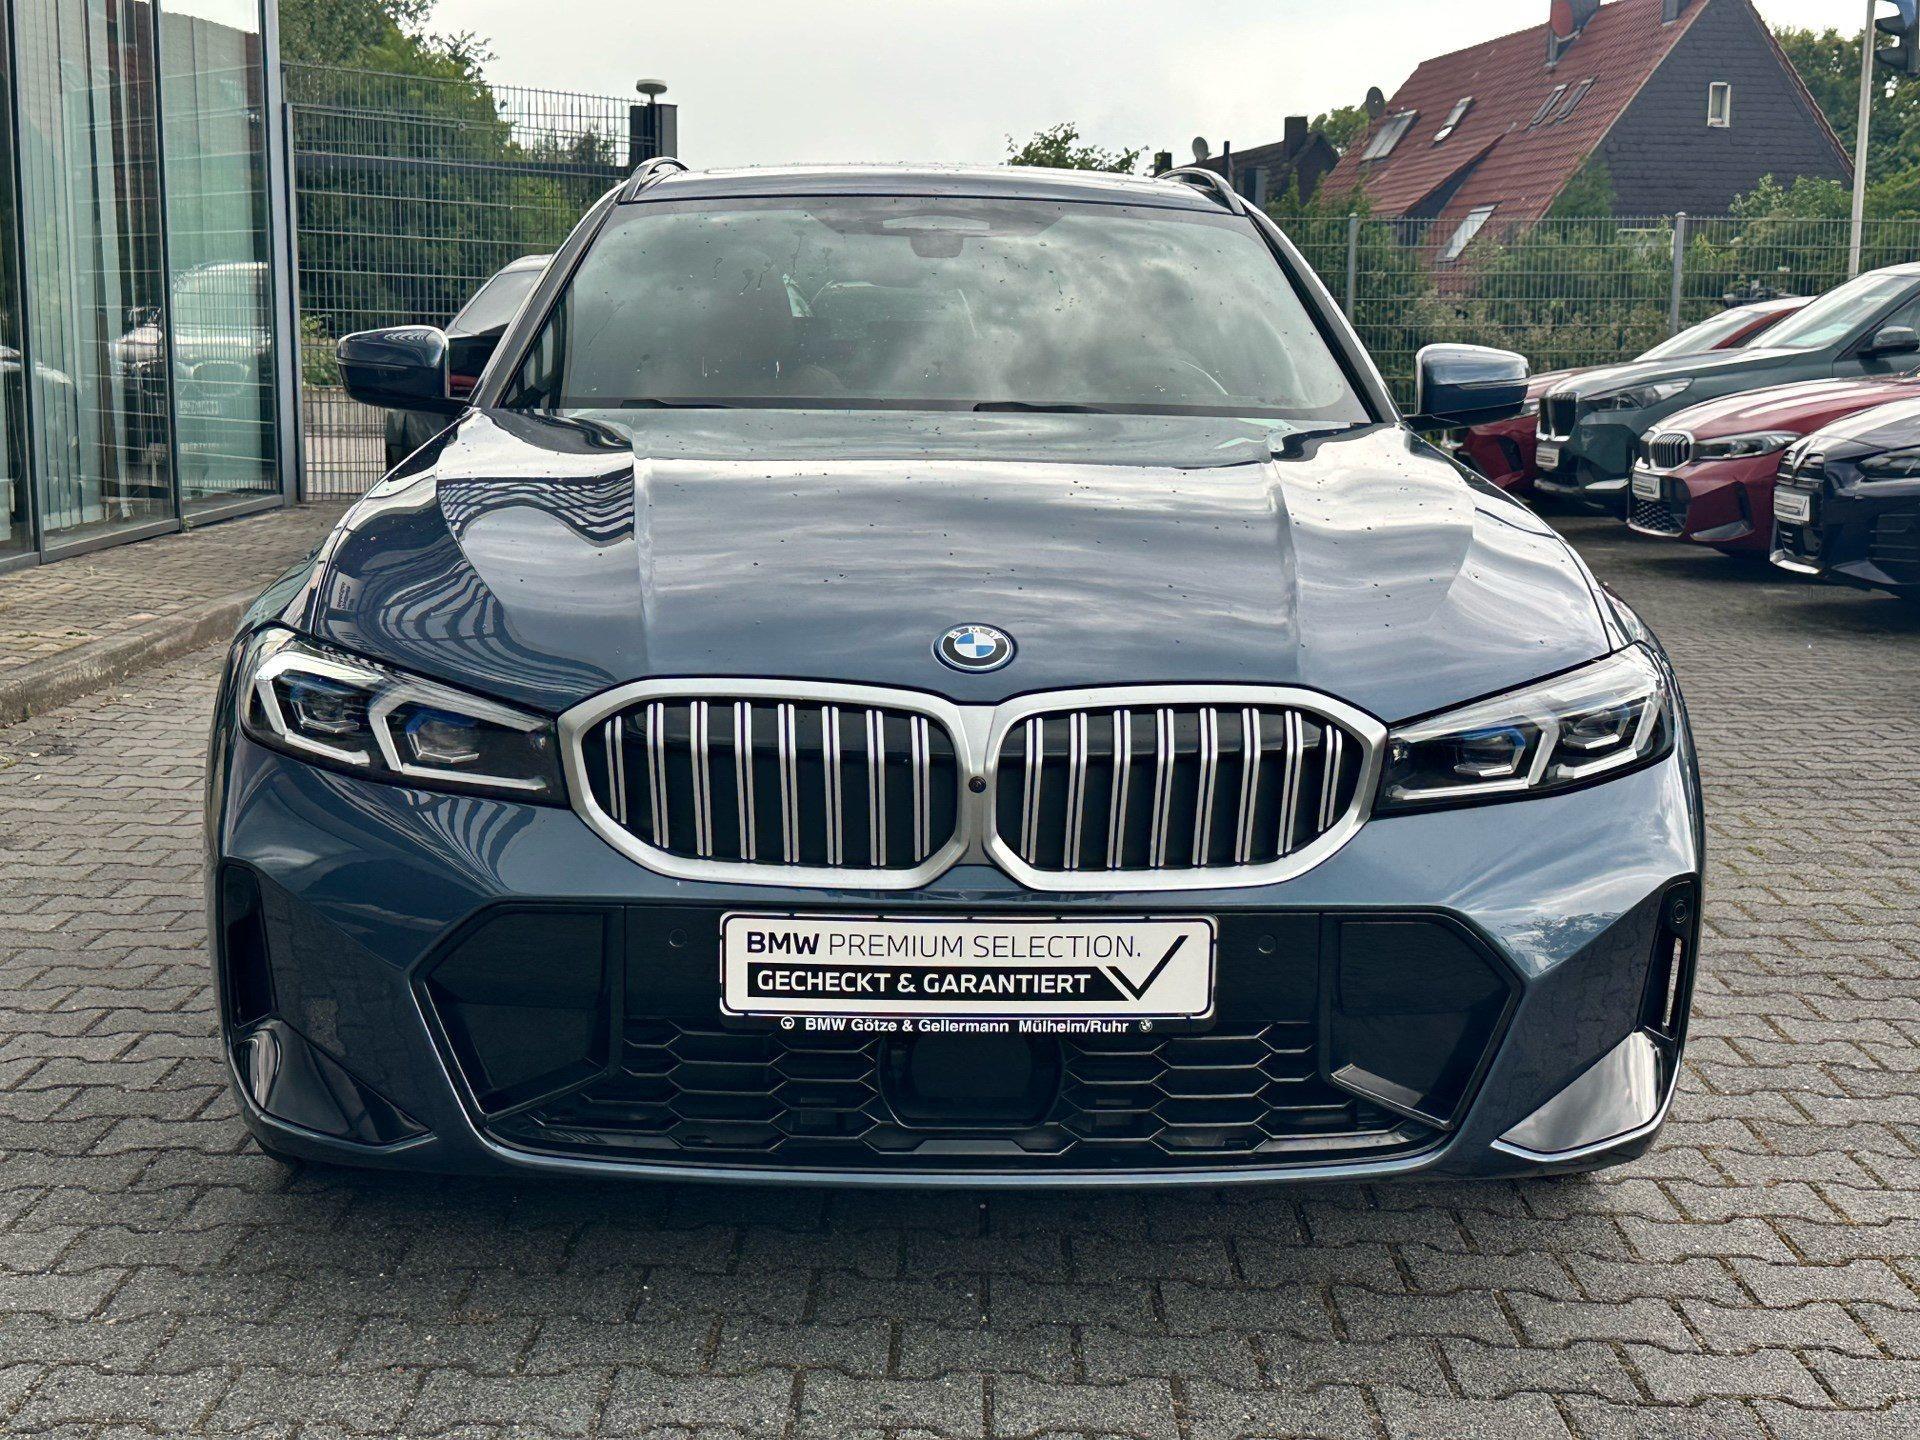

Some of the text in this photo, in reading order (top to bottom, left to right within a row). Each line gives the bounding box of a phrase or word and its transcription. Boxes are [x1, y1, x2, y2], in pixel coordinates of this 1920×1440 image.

[947, 627, 1003, 639] BMW
[747, 931, 1141, 958] BMW PREMIUM SELECTION.
[757, 970, 1091, 994] GECHECKT & GARANTIERT
[805, 1018, 1129, 1034] BMW Götze & Gellermann Mülheim/Ruhr
